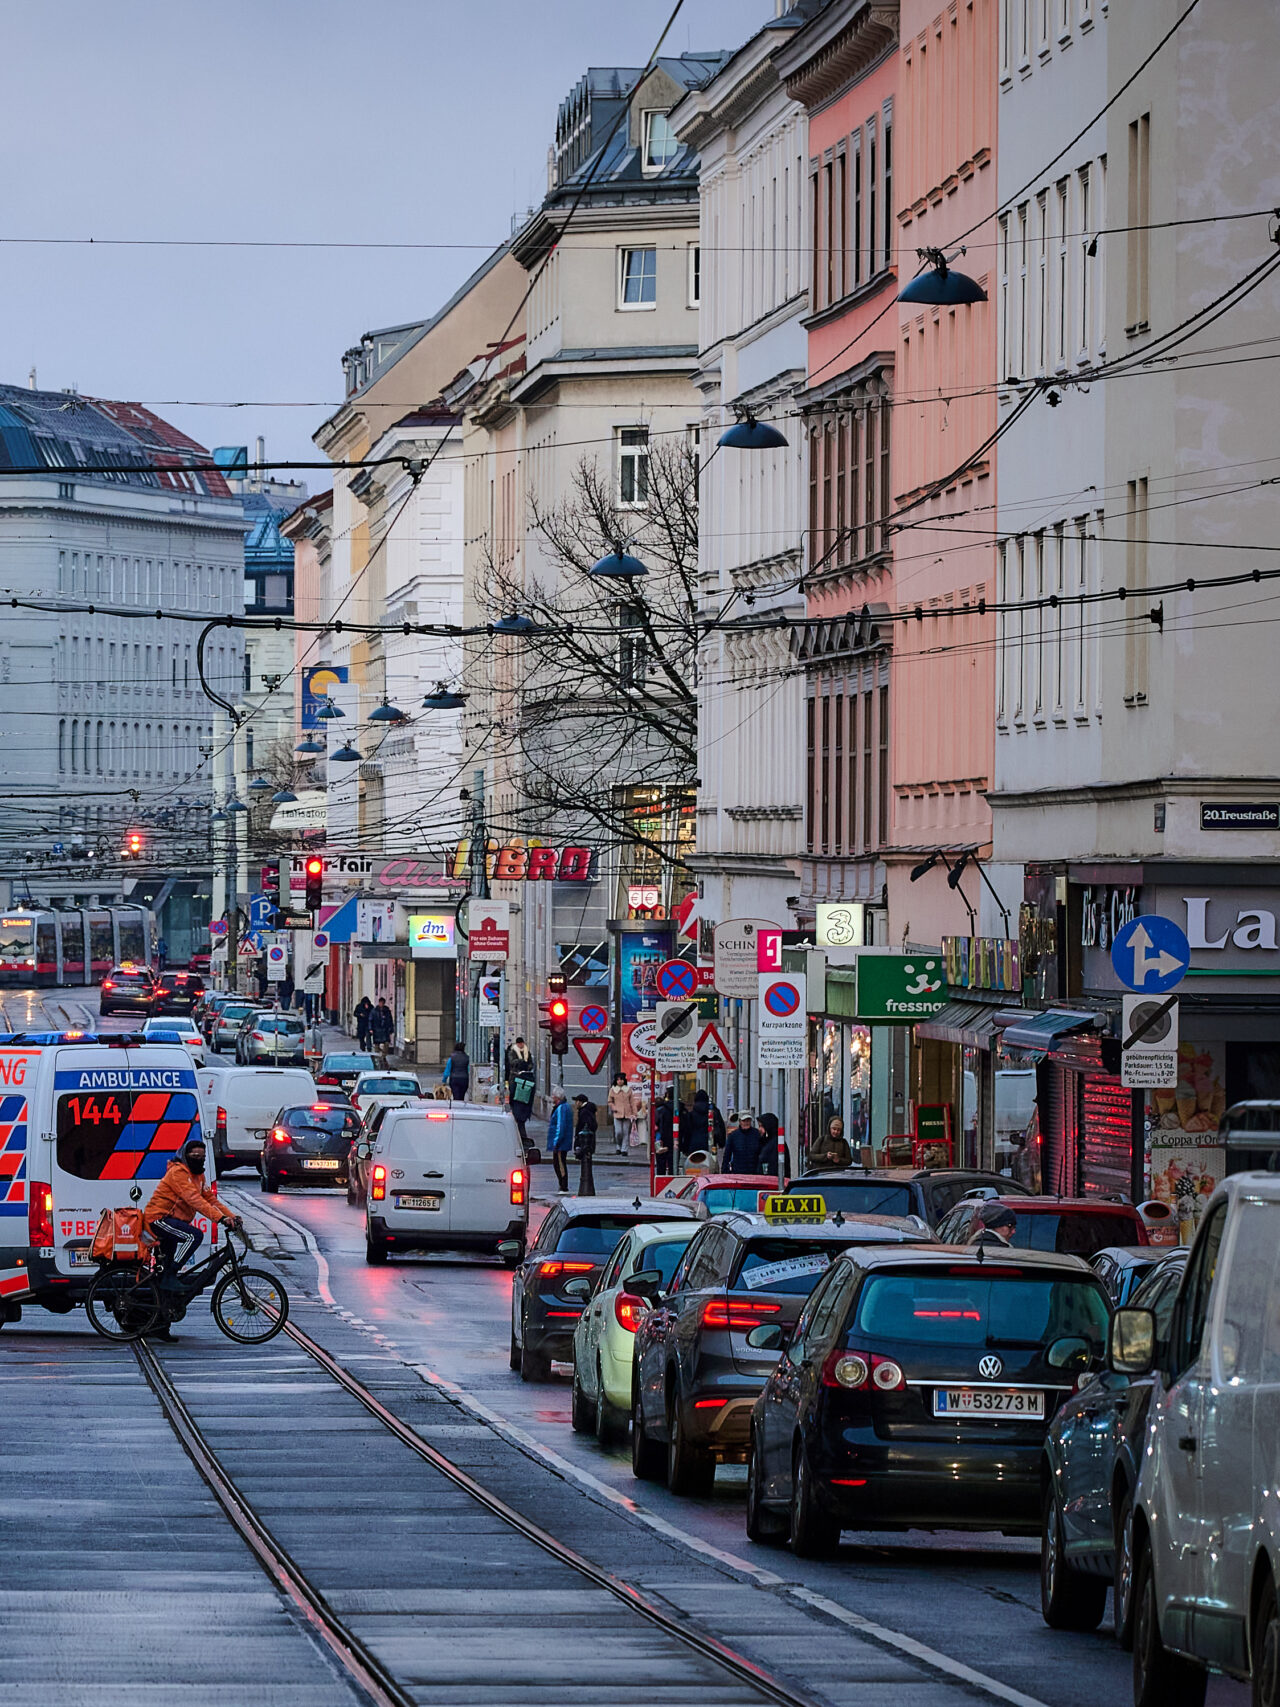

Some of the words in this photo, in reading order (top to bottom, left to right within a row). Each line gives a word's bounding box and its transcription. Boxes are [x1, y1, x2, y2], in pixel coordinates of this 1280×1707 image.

[422, 921, 445, 934] dm
[827, 909, 854, 945] 3
[761, 1021, 803, 1029] Kurzparkzone
[1126, 1054, 1174, 1062] gebührenpflichtig
[1155, 1062, 1163, 1070] 1,5
[1163, 1062, 1175, 1070] Std.
[79, 1071, 182, 1088] AMBULANCE
[68, 1096, 122, 1126] 144
[1161, 1133, 1193, 1146] Coppa
[774, 1199, 818, 1212] TAXI
[760, 1265, 787, 1278] LISTE
